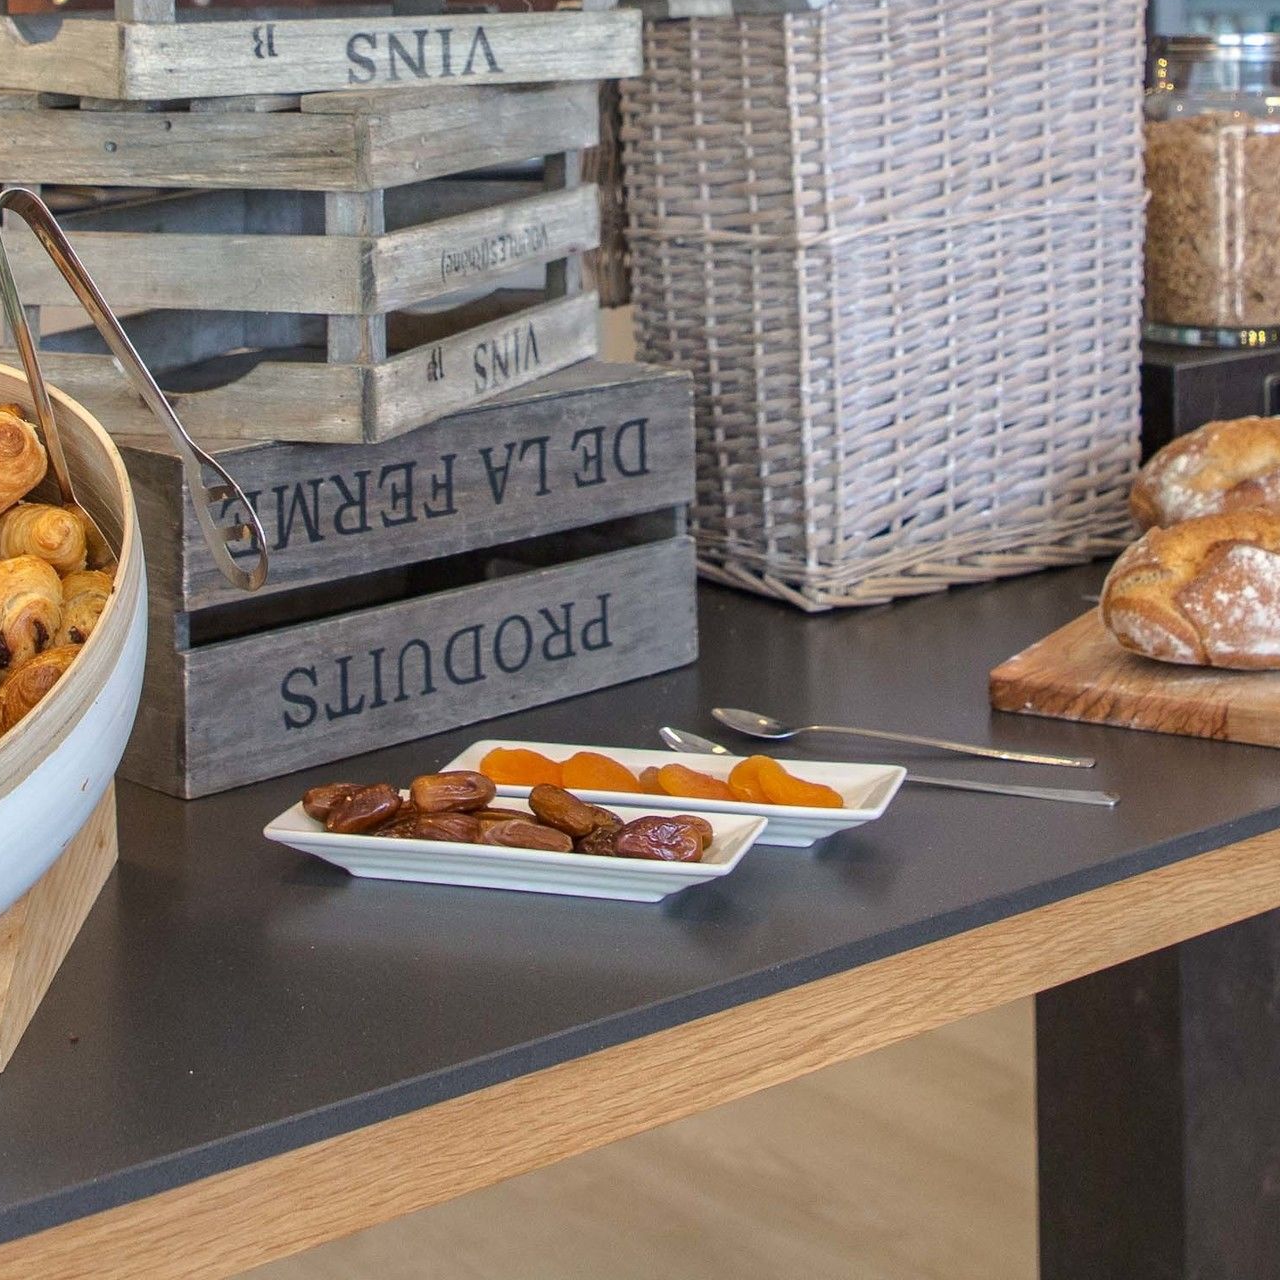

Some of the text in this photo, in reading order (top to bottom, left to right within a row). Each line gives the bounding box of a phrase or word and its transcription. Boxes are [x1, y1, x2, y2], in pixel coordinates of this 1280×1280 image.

[345, 25, 504, 85] VINS
[473, 320, 541, 394] VINS
[221, 417, 651, 559] DE LA FERME
[281, 592, 614, 731] PRODUITS
